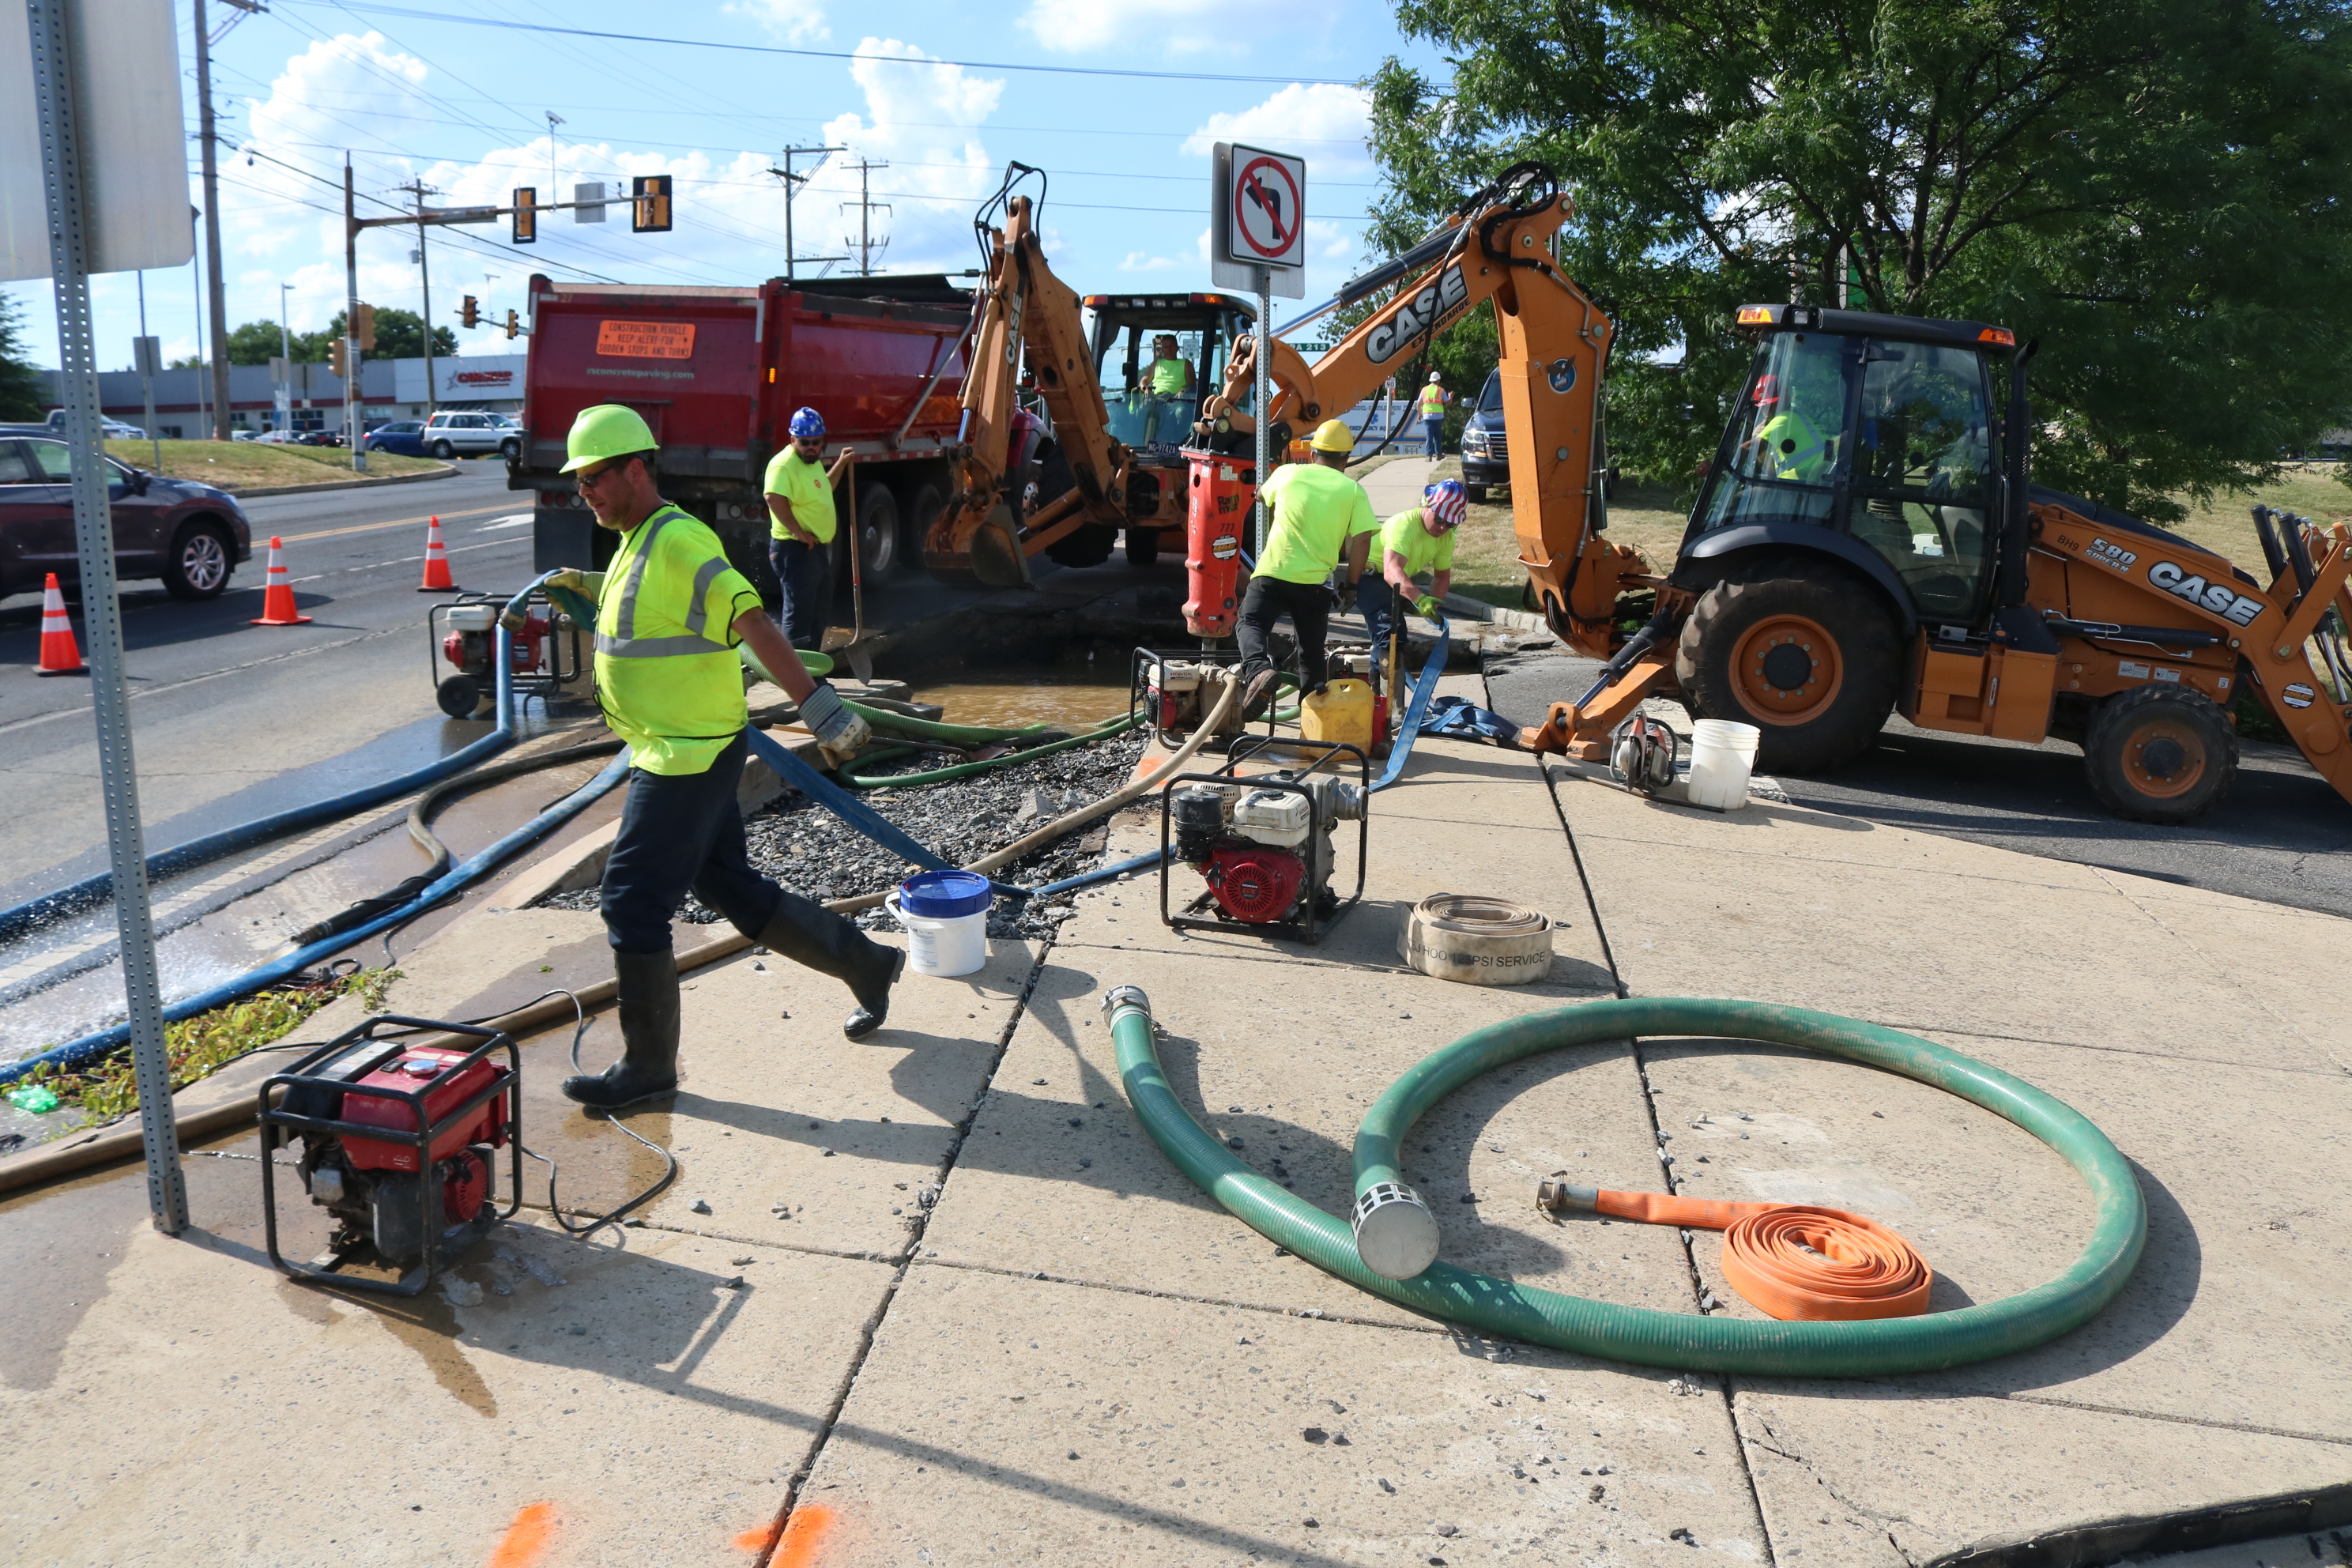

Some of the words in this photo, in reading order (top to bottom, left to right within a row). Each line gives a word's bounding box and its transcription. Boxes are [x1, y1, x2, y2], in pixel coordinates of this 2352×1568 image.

[1366, 265, 1466, 363] CASE
[609, 322, 657, 334] CONSTRUCTION
[661, 325, 686, 334] VEHICLE
[1005, 292, 1022, 364] CASE
[617, 334, 634, 343] KEEP
[638, 335, 658, 344] ALERT
[661, 336, 674, 345] FOR
[598, 344, 624, 352] SUDDEN
[628, 345, 648, 355] STOPS
[651, 347, 665, 356] AND
[669, 348, 690, 356] TURNS
[1220, 523, 1235, 533] 777
[2057, 534, 2079, 552] BH9
[2089, 537, 2138, 565] 580
[2085, 548, 2120, 568] SUPER
[2148, 560, 2266, 627] CASE
[1496, 951, 1545, 967] SERVICE
